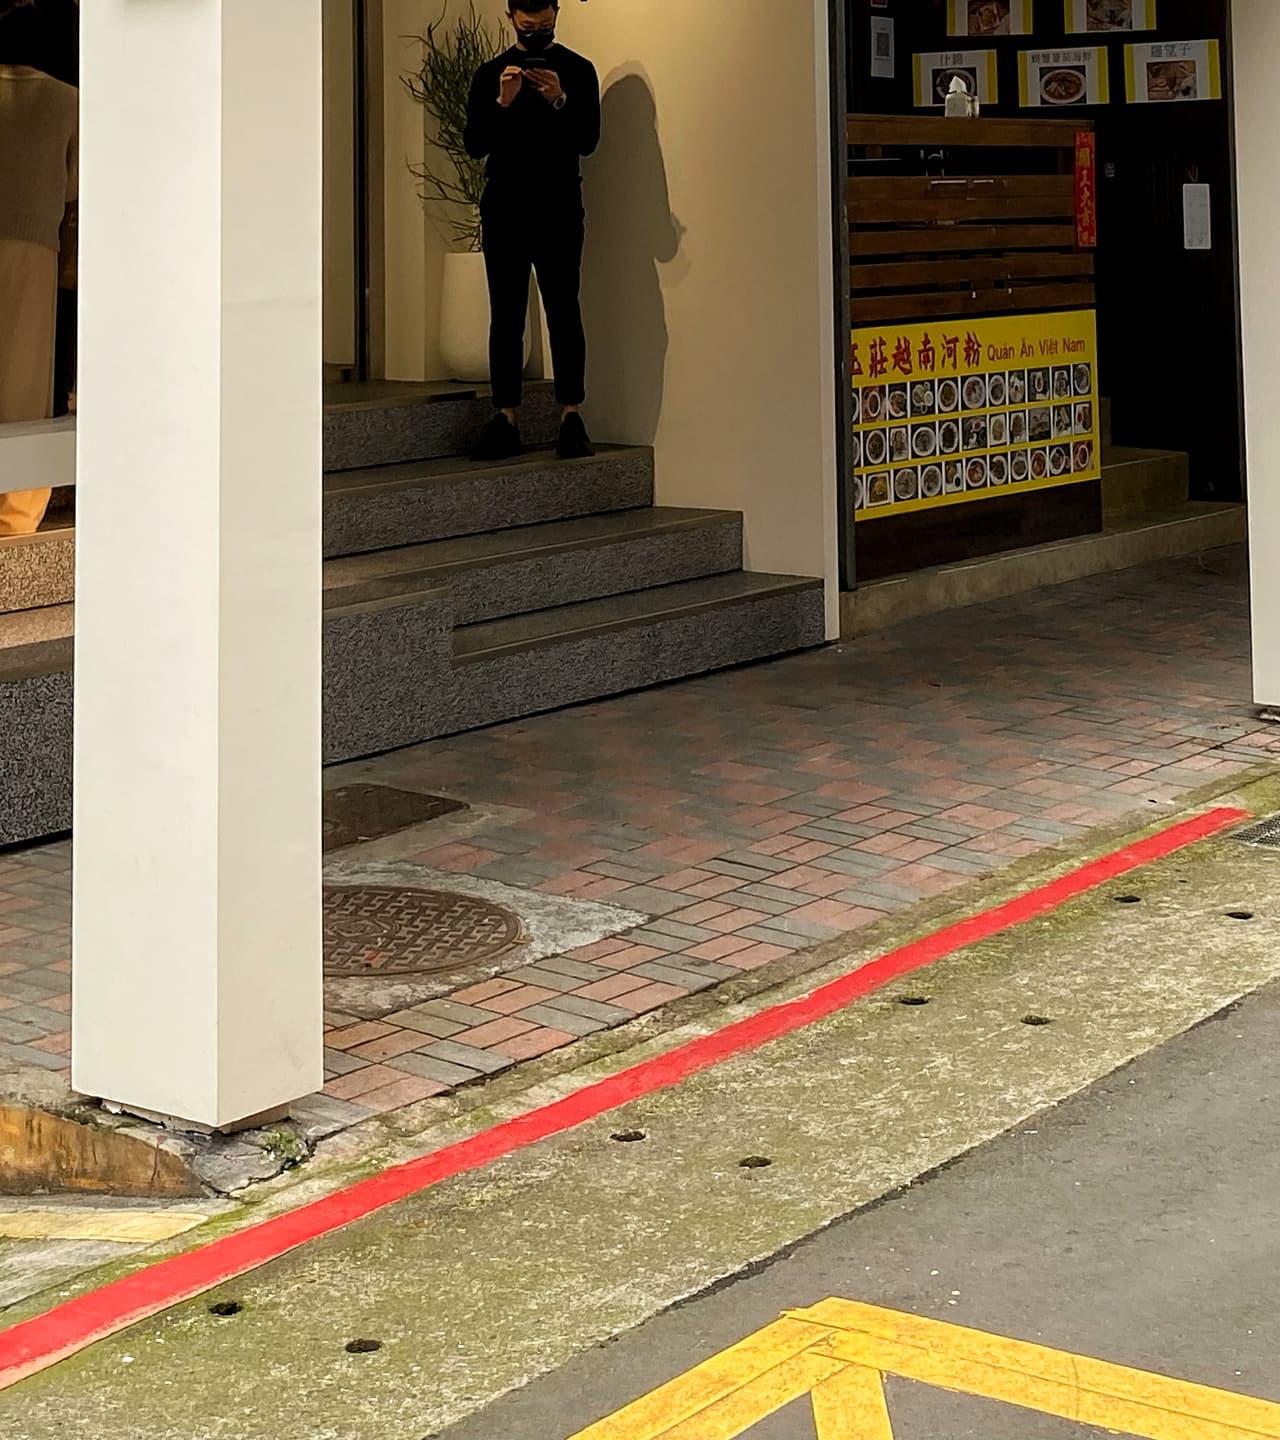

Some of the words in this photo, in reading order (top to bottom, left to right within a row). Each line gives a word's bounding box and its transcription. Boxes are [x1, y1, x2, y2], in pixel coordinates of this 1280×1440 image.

[848, 331, 982, 379] 玉莊越南河粉
[1062, 337, 1086, 353] Nam
